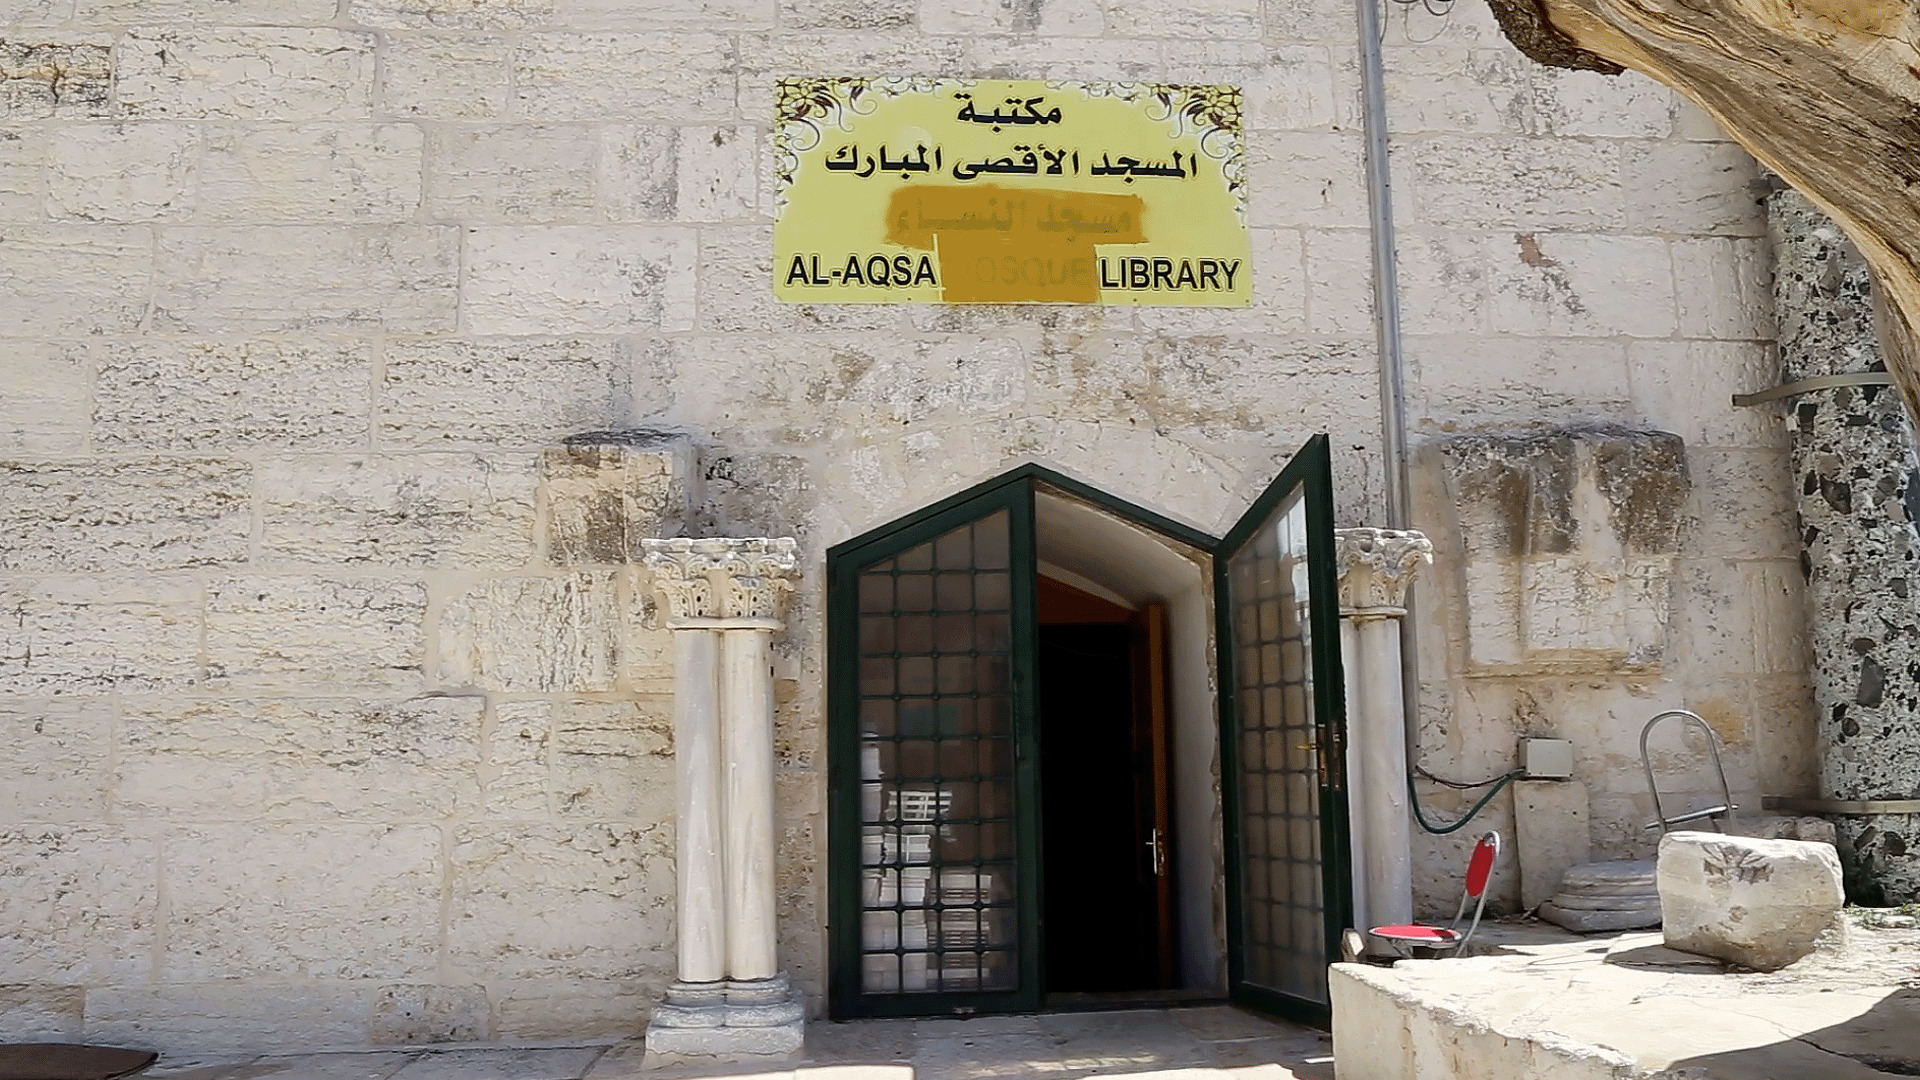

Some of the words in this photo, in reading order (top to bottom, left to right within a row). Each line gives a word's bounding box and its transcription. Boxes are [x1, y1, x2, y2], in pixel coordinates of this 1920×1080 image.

[953, 92, 1062, 133] مكتبة
[824, 144, 942, 180] المبارك
[952, 143, 1079, 181] الأقصى
[1090, 150, 1198, 184] المسجد
[786, 255, 937, 287] AL-AQSA
[943, 255, 1092, 288] OSQUE
[1101, 258, 1240, 290] LIBRARY
